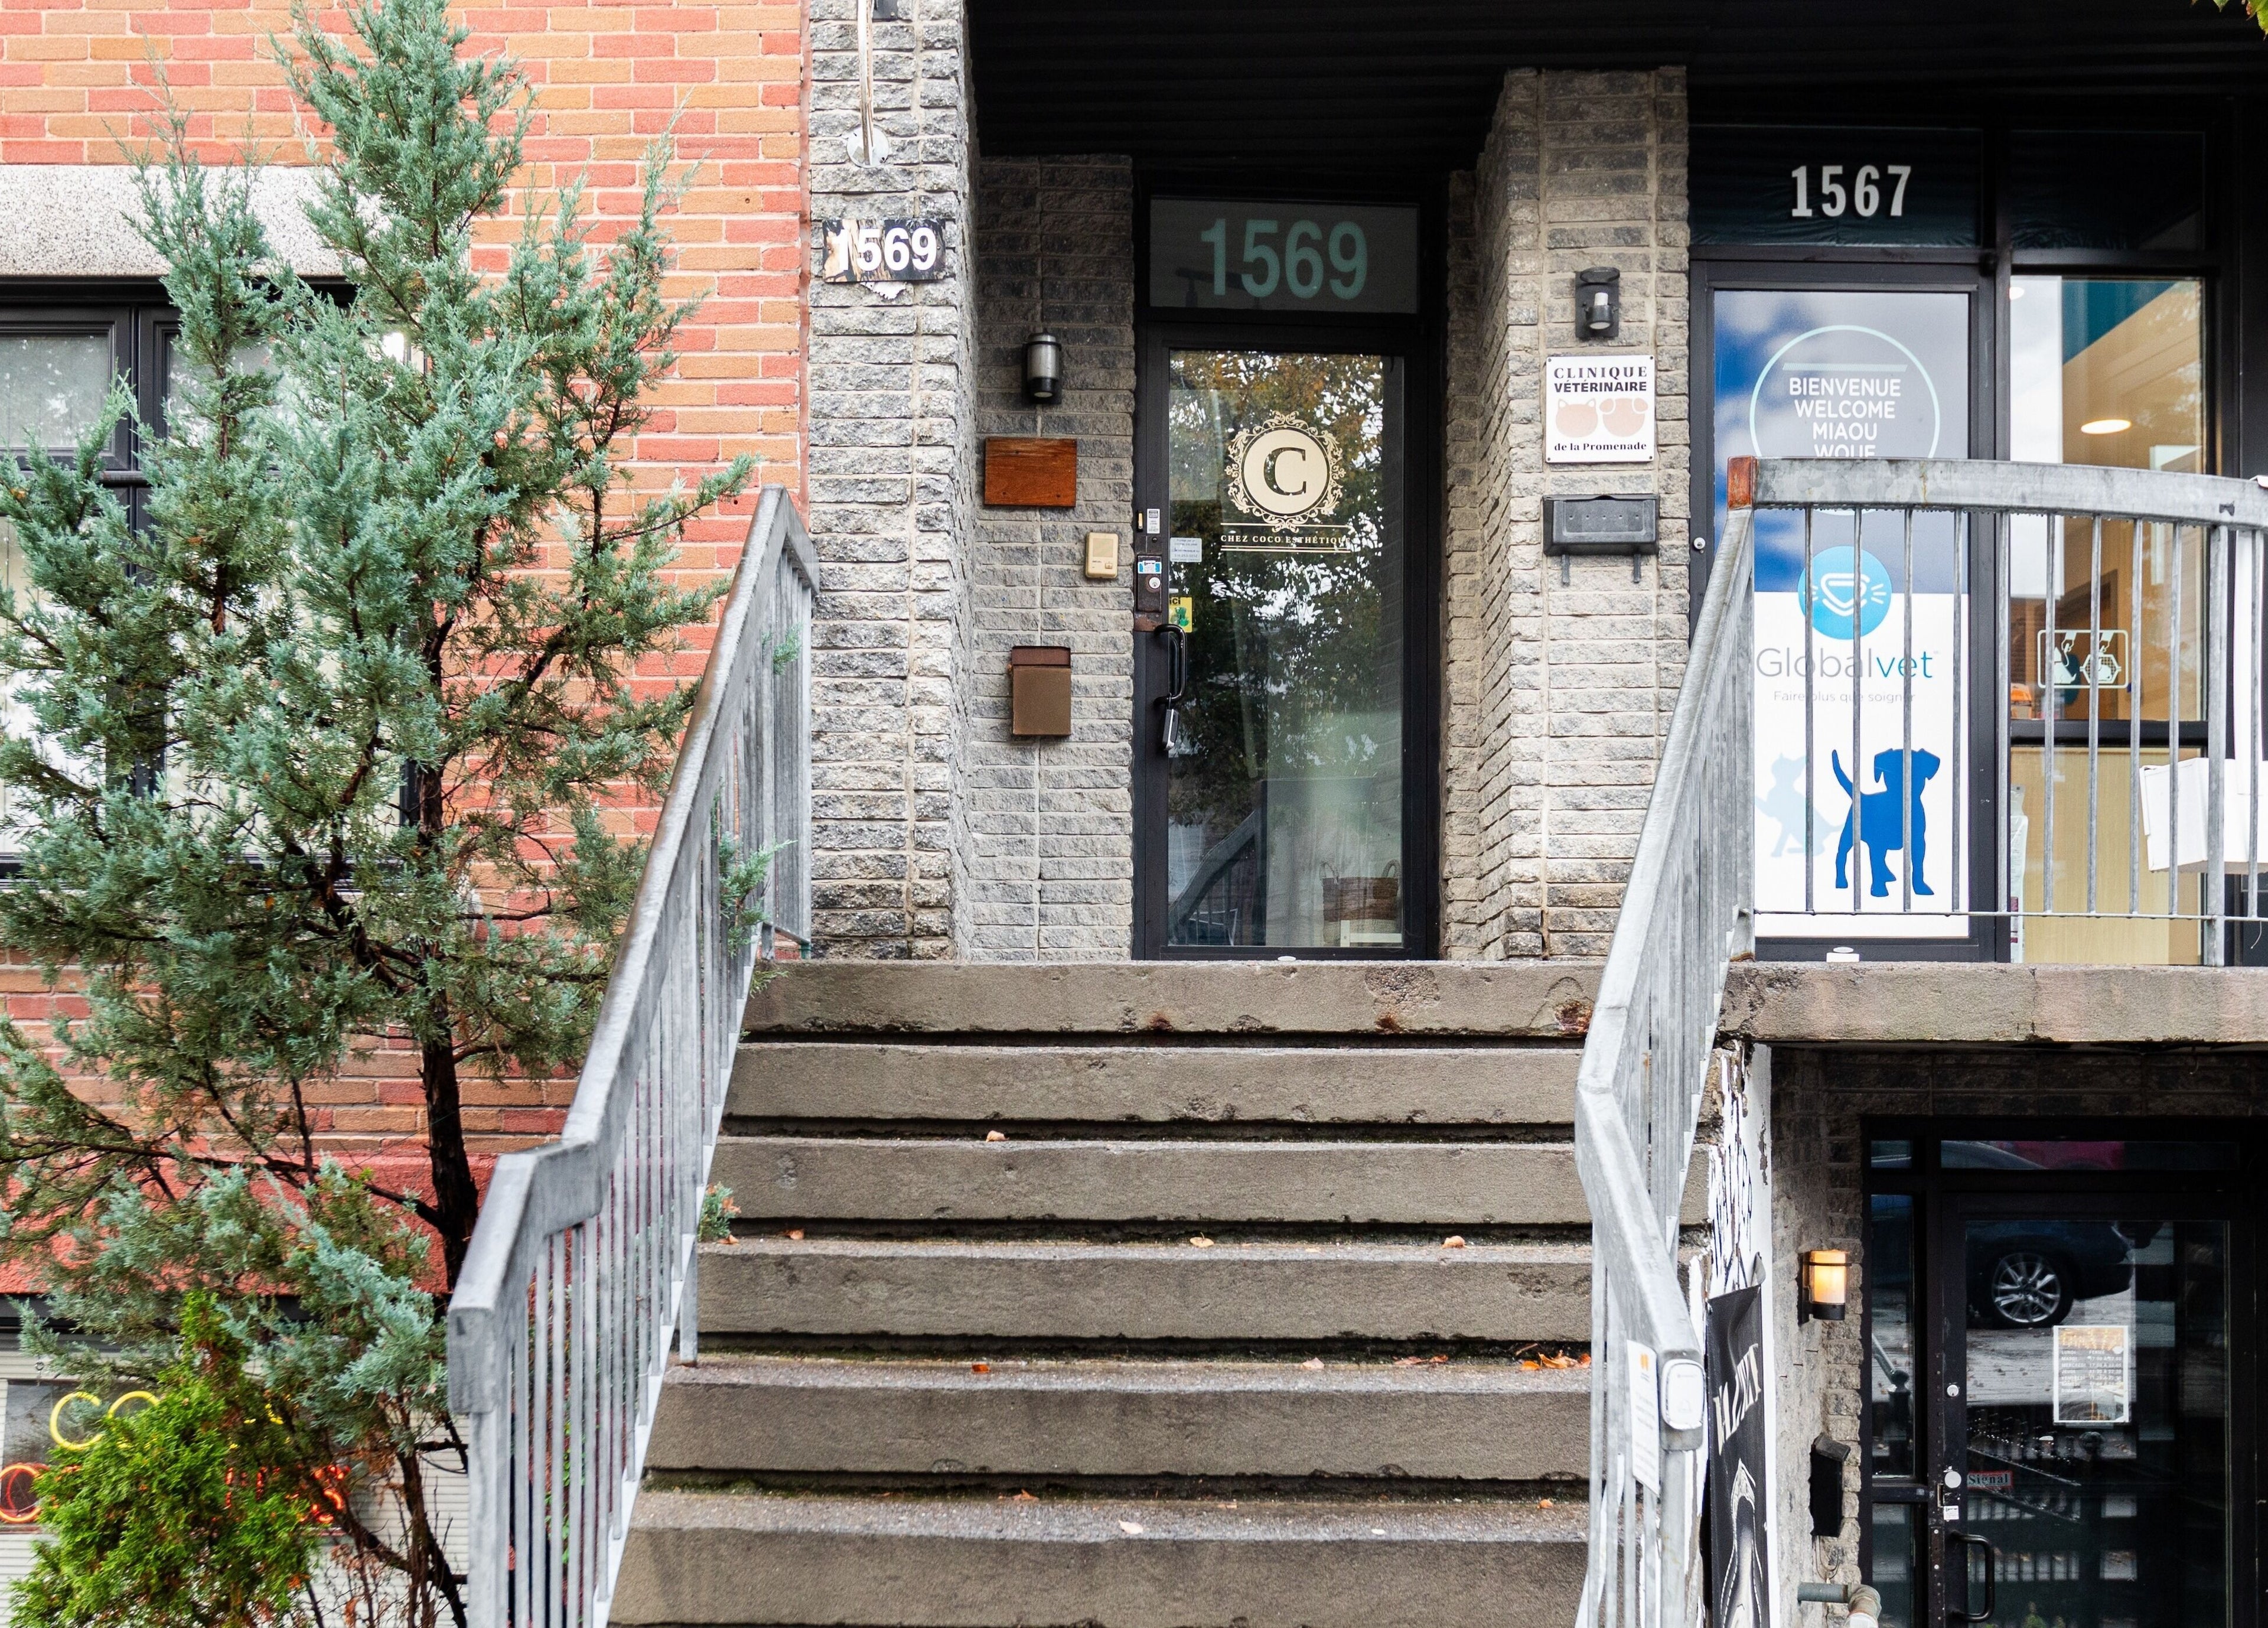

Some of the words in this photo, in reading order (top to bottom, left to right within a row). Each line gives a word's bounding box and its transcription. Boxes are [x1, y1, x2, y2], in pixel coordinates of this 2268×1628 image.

[1791, 165, 1912, 217] 1567
[830, 227, 937, 272] 1569
[1200, 218, 1368, 300] 1569
[1553, 366, 1648, 380] CLINIQUE
[1554, 379, 1647, 393] VÉTÉRINAIRE
[1790, 377, 1901, 397] BIENVENUE
[1794, 399, 1896, 419] WELCOME
[1813, 422, 1877, 441] MIAOU
[1554, 441, 1568, 451] de
[1570, 441, 1581, 451] la
[1583, 441, 1647, 451] Promenade
[1263, 447, 1306, 496] C
[1285, 535, 1351, 544] ESTHÉTIQUE
[1756, 647, 1933, 678] Globalvet
[1774, 691, 1806, 701] Faire
[1868, 691, 1916, 704] soignr
[1969, 1473, 2008, 1486] Signal
